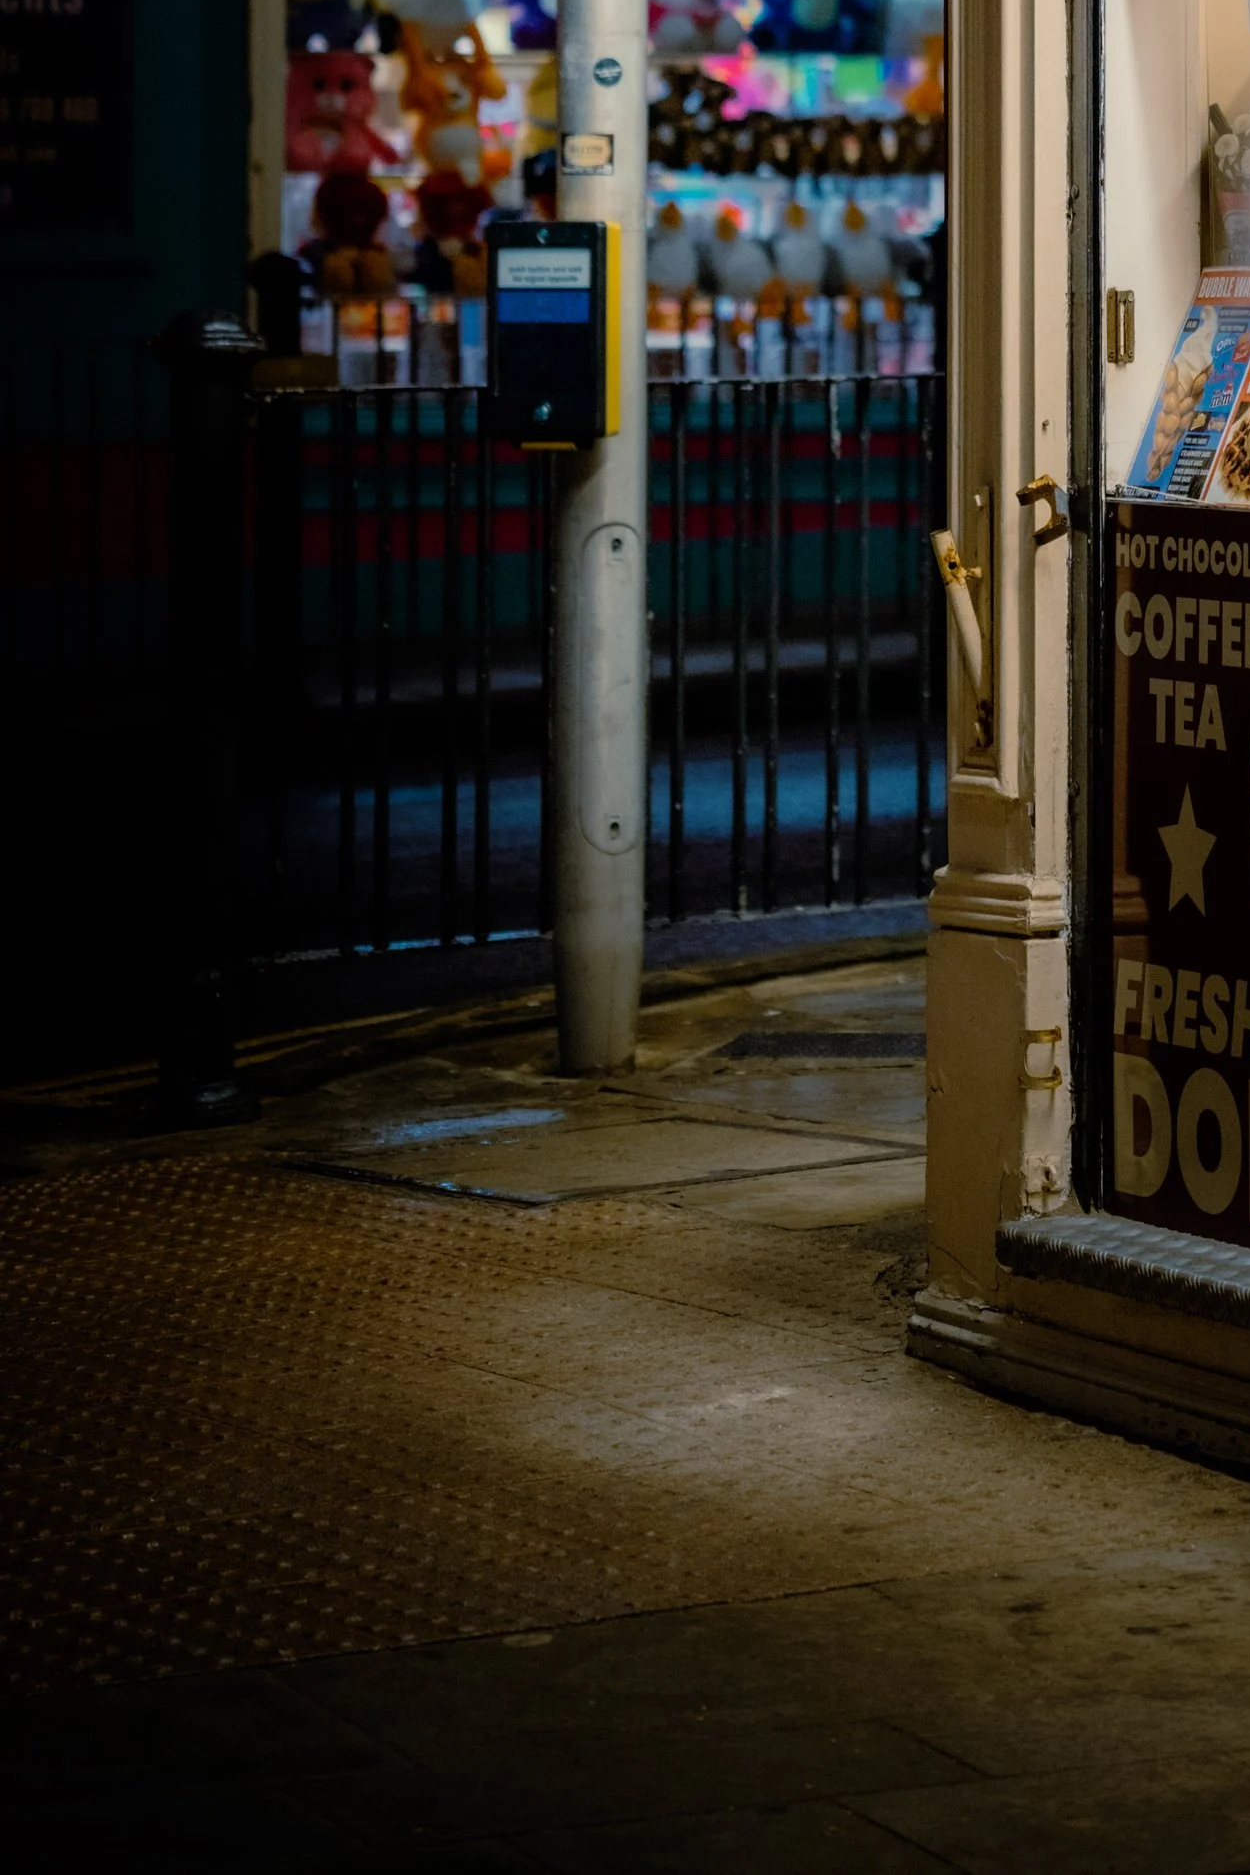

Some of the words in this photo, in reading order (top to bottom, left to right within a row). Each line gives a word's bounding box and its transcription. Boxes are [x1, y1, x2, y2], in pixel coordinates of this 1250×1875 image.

[1198, 277, 1235, 299] BUBBLE
[1114, 532, 1163, 574] HOT
[1147, 676, 1228, 752] TEA
